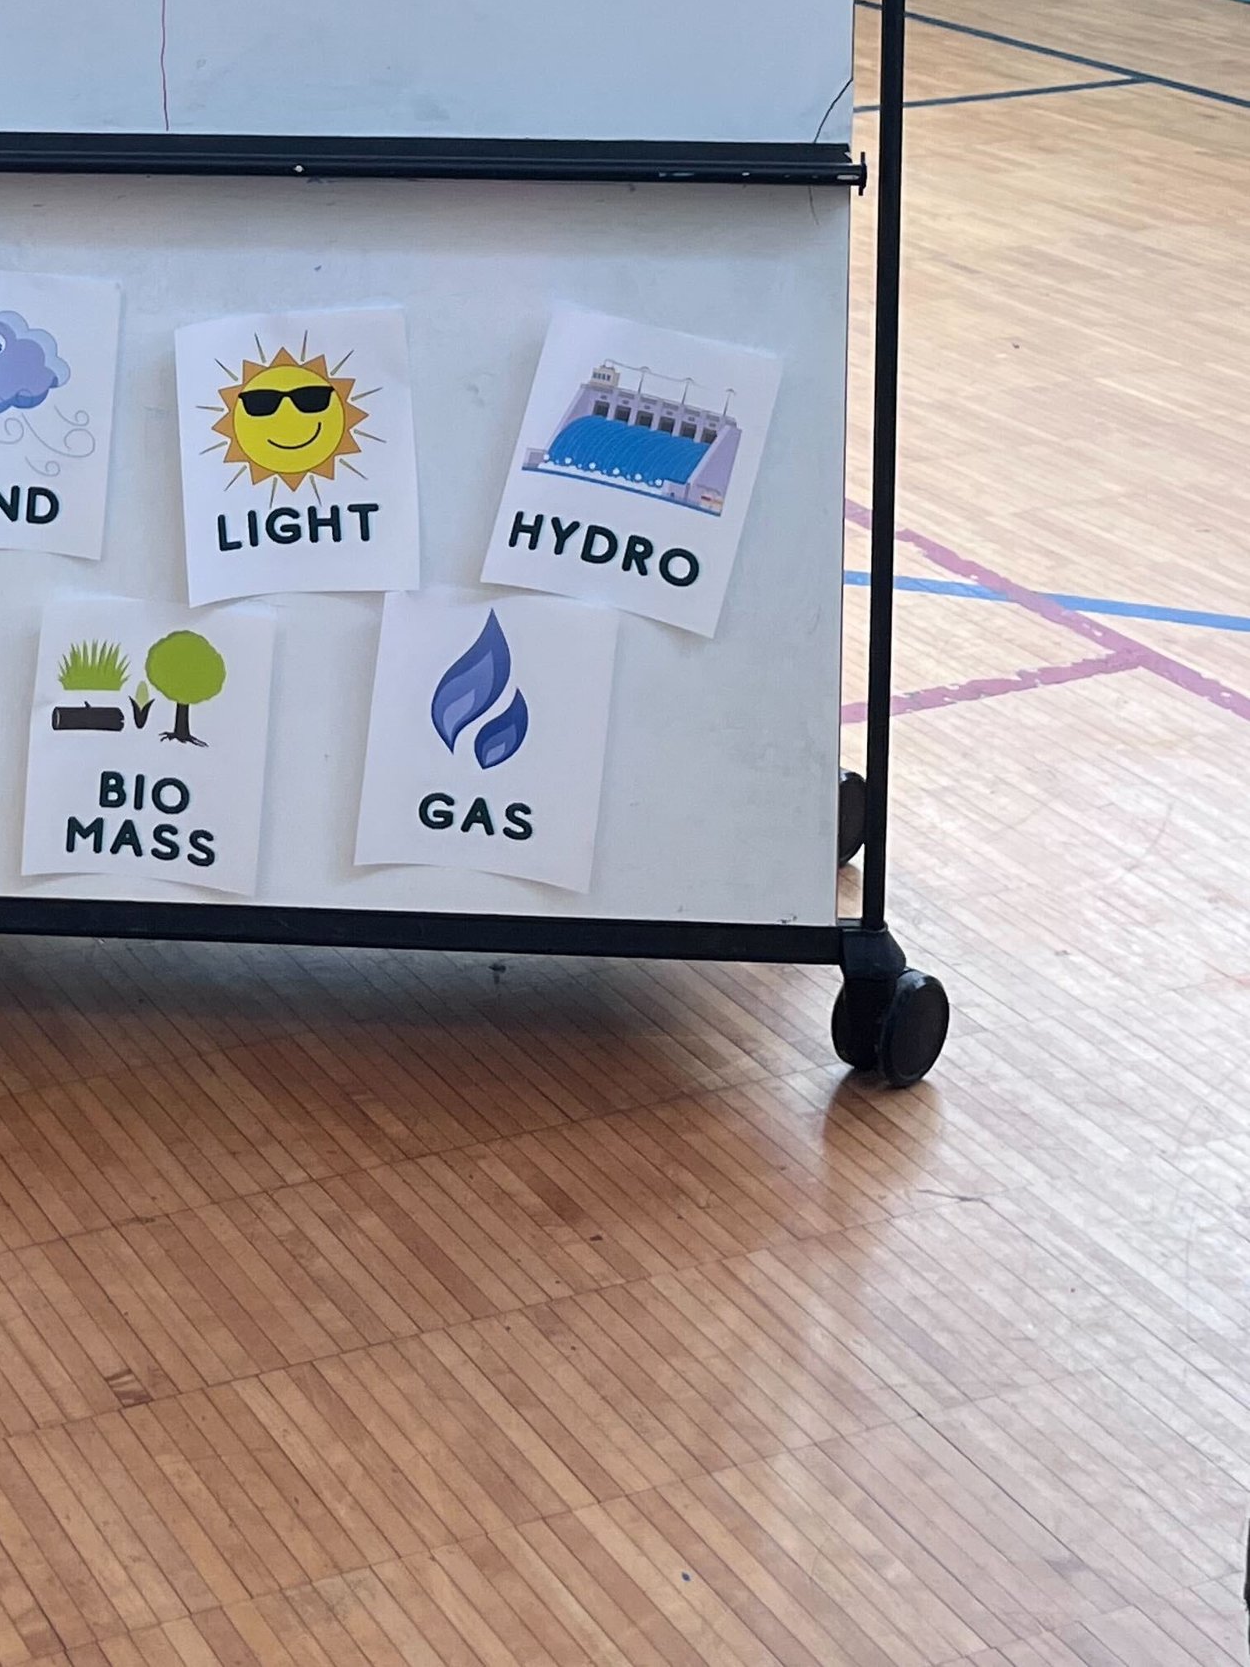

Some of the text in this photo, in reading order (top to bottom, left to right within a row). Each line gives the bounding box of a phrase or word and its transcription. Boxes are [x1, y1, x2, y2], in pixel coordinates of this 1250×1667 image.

[217, 503, 380, 552] LIGHT
[508, 511, 701, 588] HYDRO
[98, 770, 191, 815] BIO
[417, 792, 534, 841] GAS
[65, 816, 217, 868] MASS
